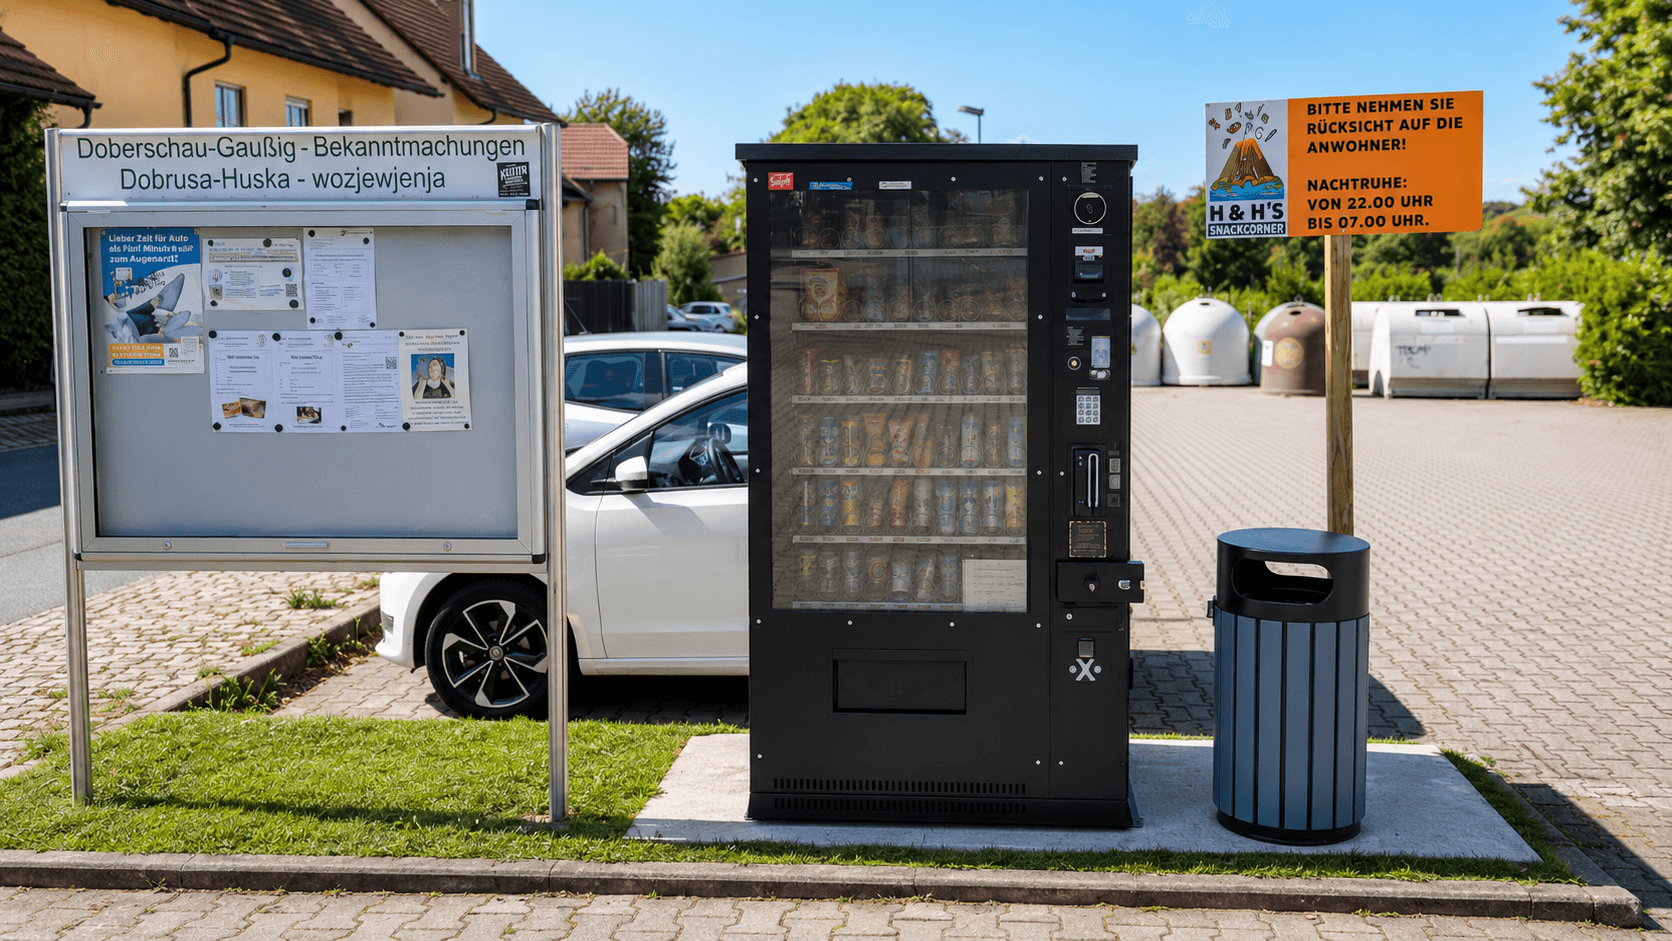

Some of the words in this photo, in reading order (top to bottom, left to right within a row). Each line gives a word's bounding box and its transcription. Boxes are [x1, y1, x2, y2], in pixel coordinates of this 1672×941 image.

[1307, 102, 1351, 116] BITTE
[1357, 99, 1424, 113] NEHMEN
[1430, 97, 1455, 111] SIE
[1306, 118, 1394, 135] RÜCKSICHT
[1398, 117, 1431, 131] AUF
[1436, 116, 1463, 130] DIE
[76, 136, 296, 163] Doberschau-Gaußig
[313, 135, 525, 162] Bekanntmachungen
[1306, 138, 1406, 154] ANWOHNER!
[120, 167, 291, 190] Dobrusa-Huska
[312, 166, 446, 194] wozjewjenja
[1307, 176, 1407, 192] NACHTRUHE:
[1209, 205, 1224, 221] H
[1228, 204, 1245, 221] &
[1251, 201, 1284, 221] H'S
[1307, 198, 1342, 211] VON
[1347, 196, 1395, 210] 22.00
[1400, 195, 1434, 208] UHR
[1209, 223, 1285, 236] SNACKCORNER
[1307, 217, 1333, 230] BIS
[1338, 216, 1386, 229] 07.00
[1392, 214, 1430, 227] UHR.
[108, 234, 135, 242] Lieber
